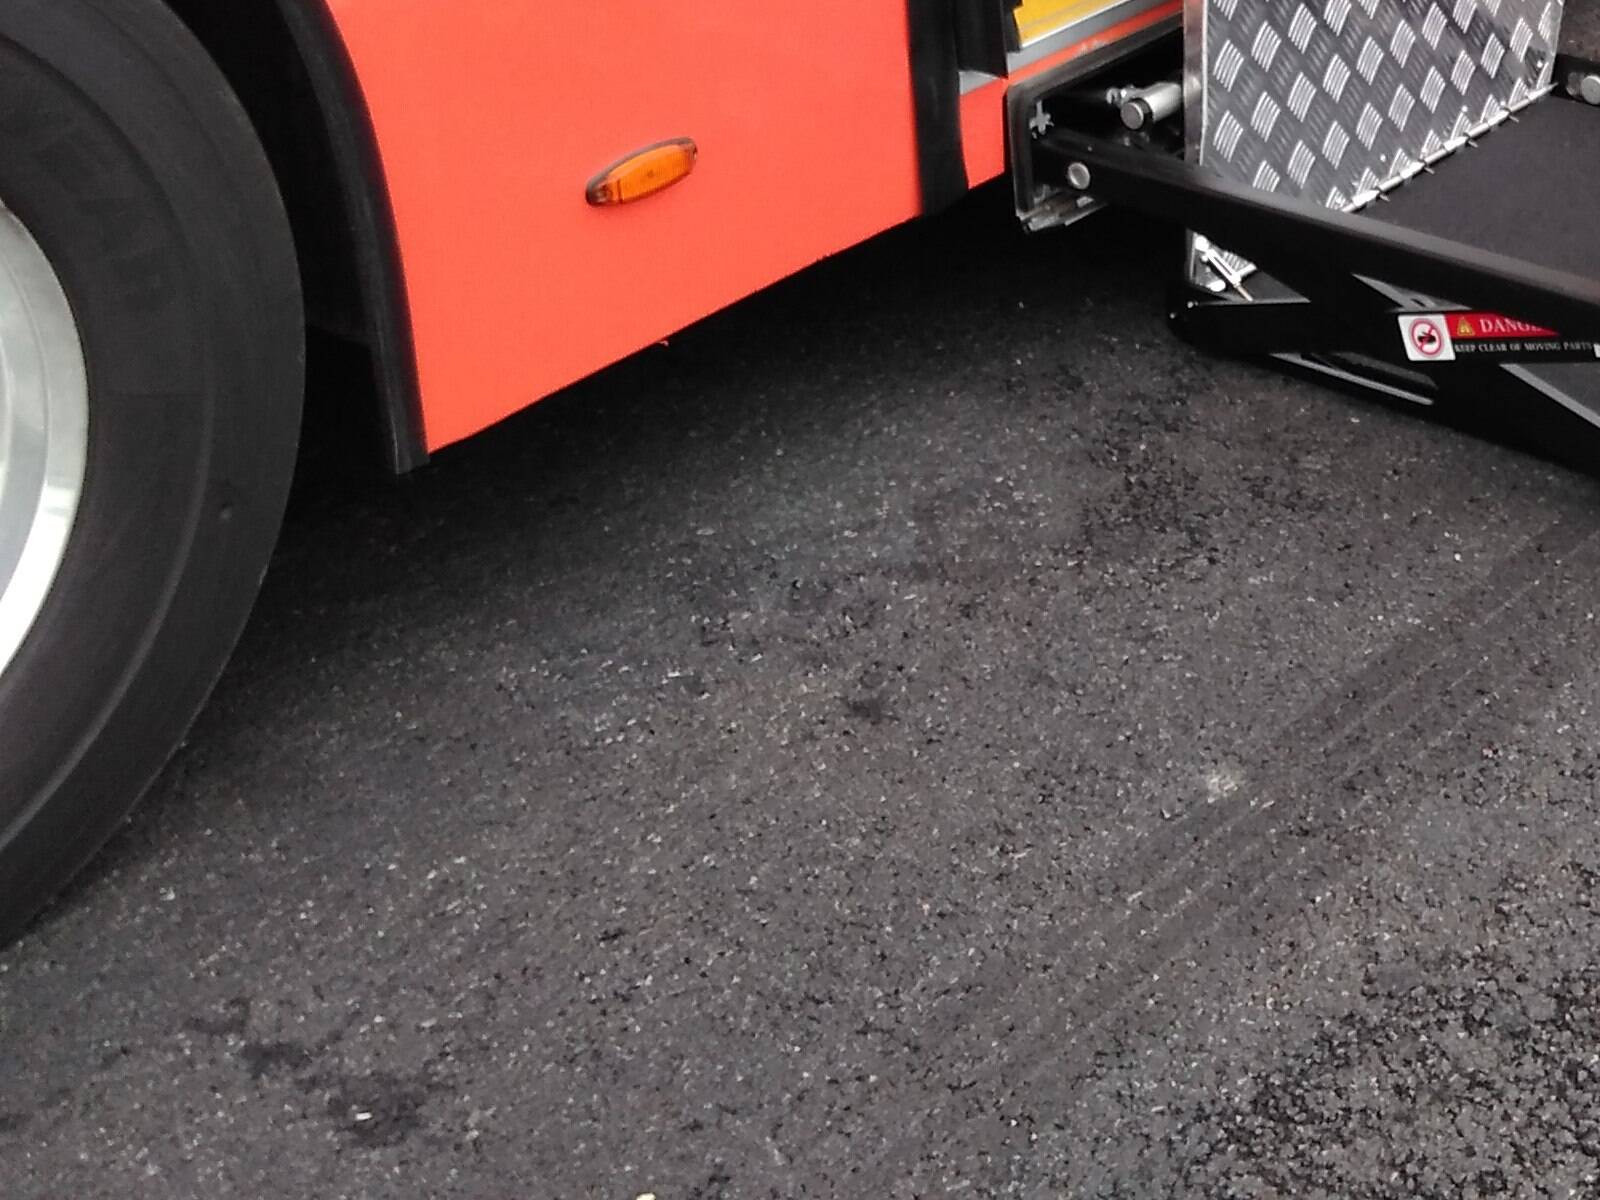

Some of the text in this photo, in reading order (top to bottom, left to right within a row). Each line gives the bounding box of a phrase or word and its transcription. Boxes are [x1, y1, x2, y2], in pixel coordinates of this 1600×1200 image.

[1479, 317, 1543, 334] DANG
[1454, 340, 1593, 353] KEEP CLEAR OF MOVING PARTS
